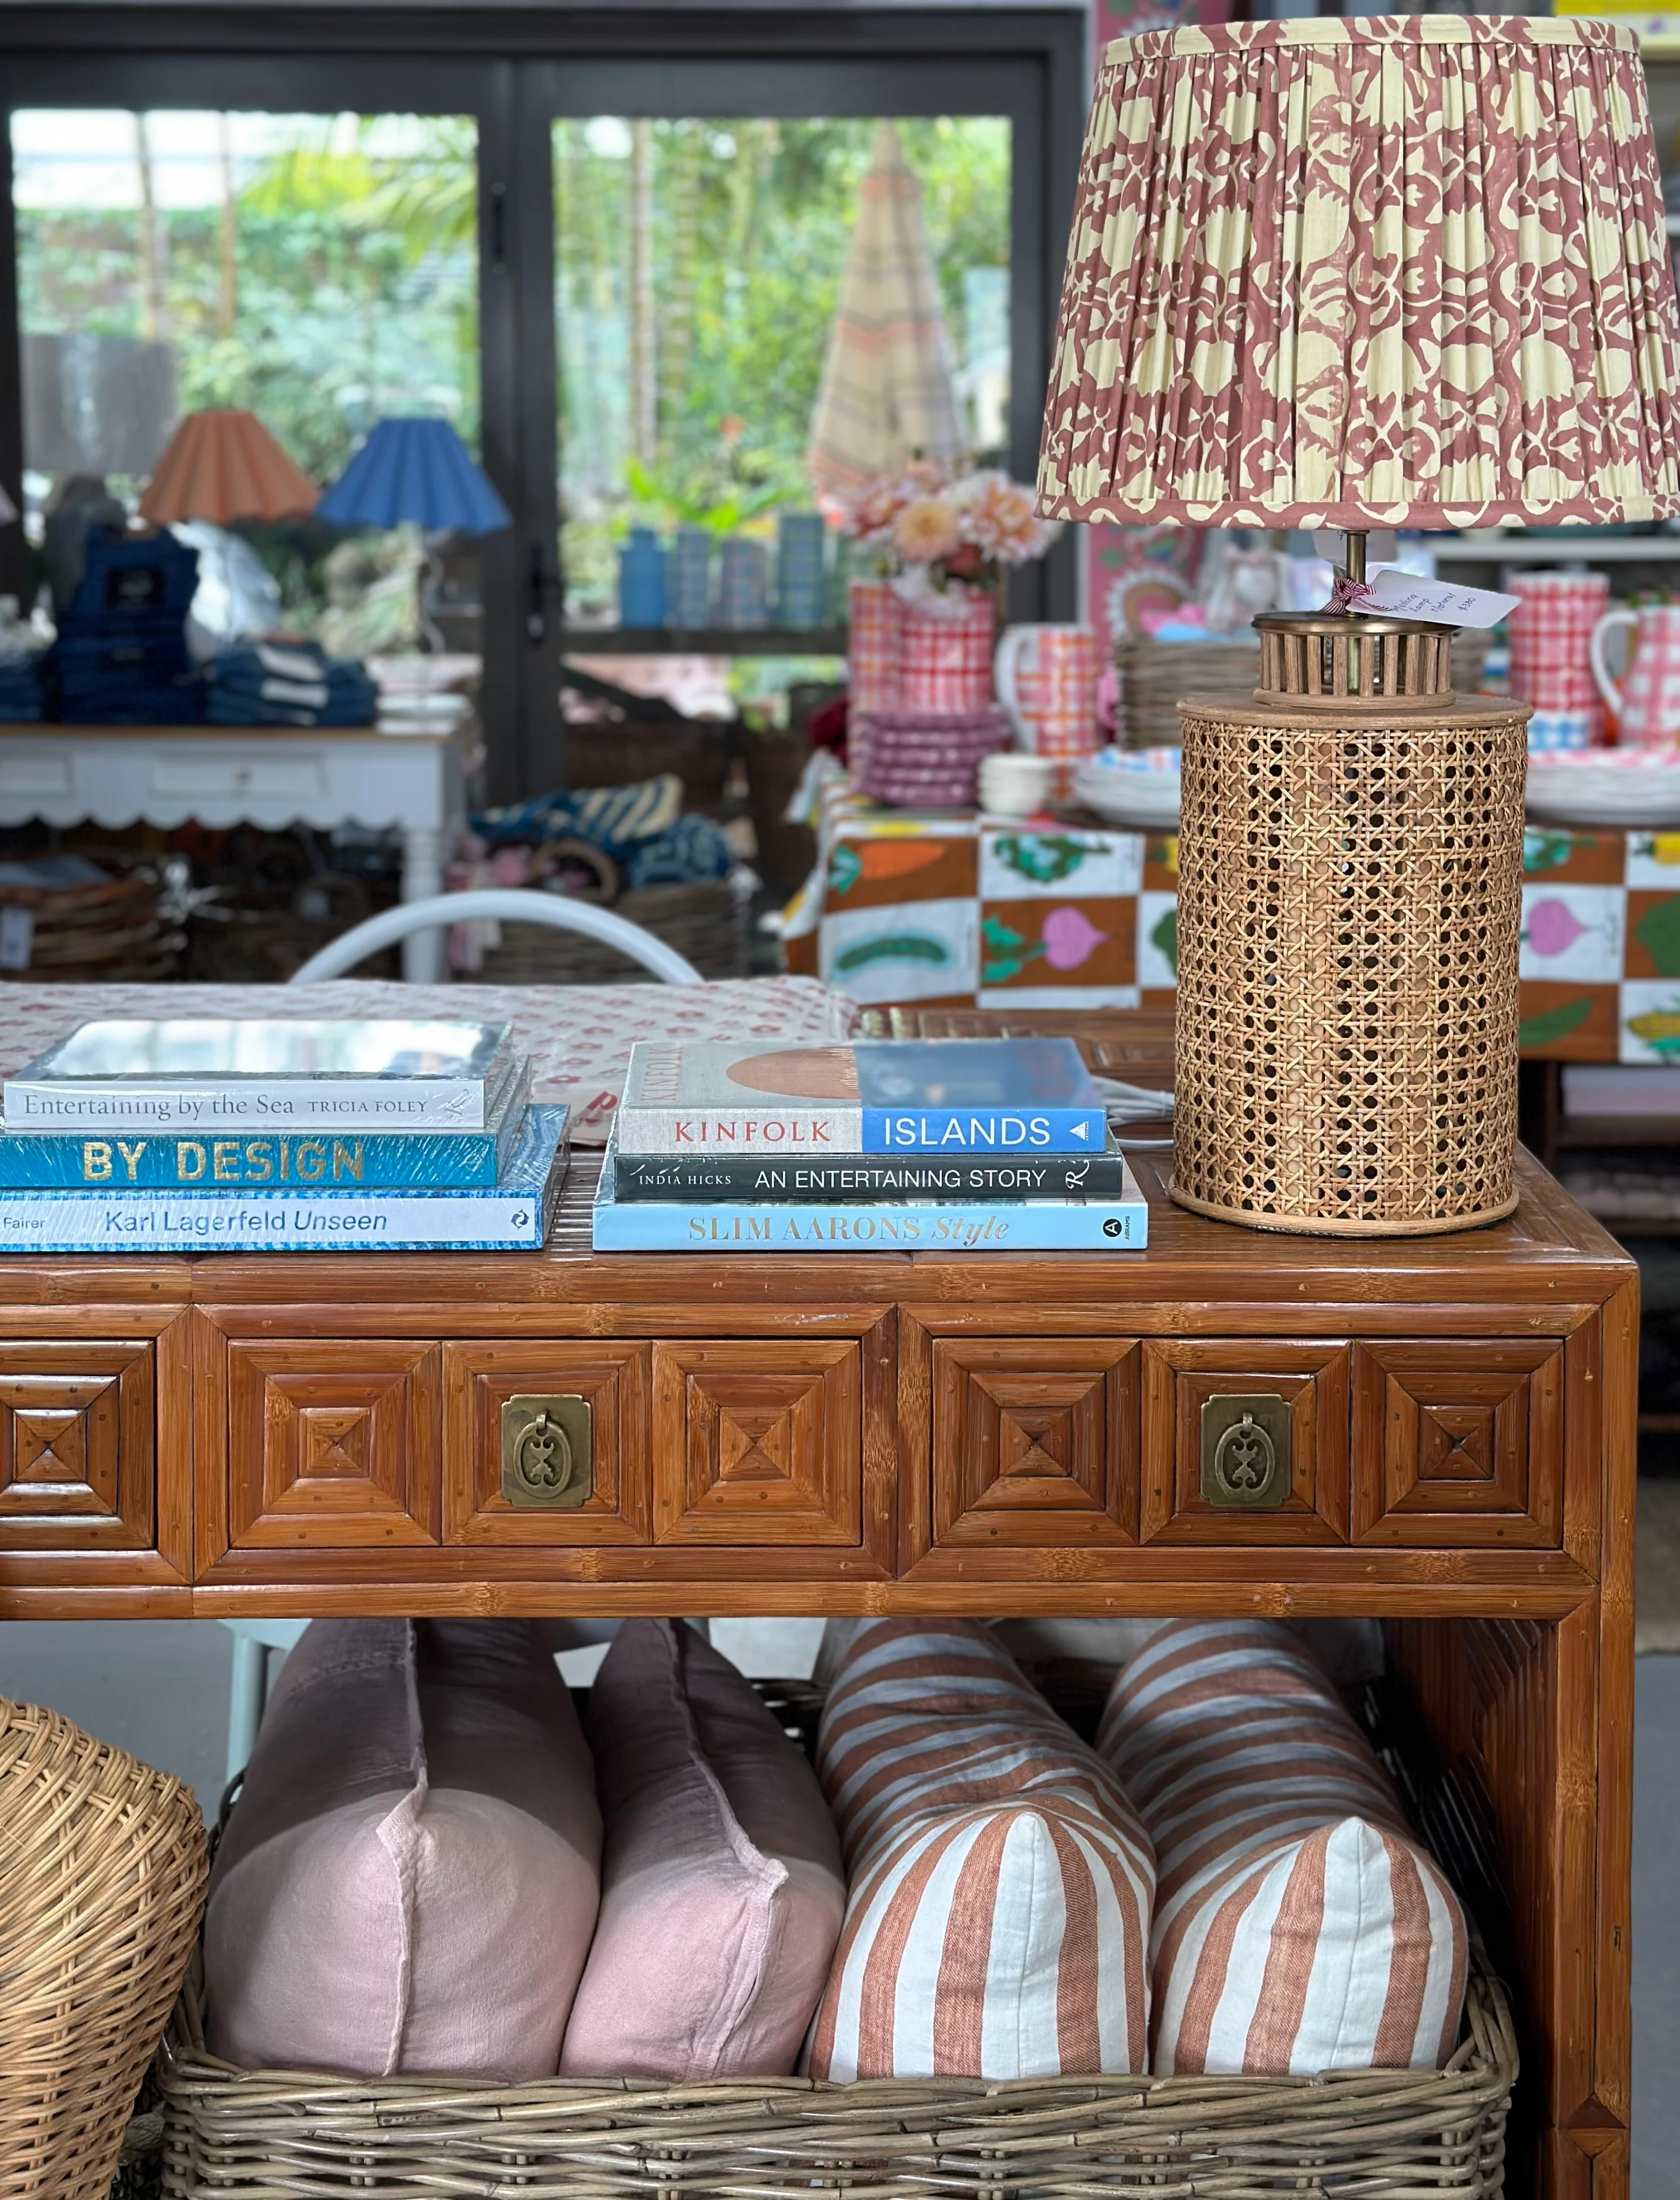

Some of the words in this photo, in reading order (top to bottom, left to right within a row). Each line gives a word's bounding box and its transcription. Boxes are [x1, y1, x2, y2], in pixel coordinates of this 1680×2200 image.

[641, 1047, 684, 1101] KINFOLK
[24, 1094, 171, 1121] Entertaining
[179, 1093, 204, 1121] by
[212, 1092, 247, 1114] the
[256, 1094, 294, 1114] Sea
[307, 1101, 369, 1113] TRICIA
[375, 1101, 429, 1113] FOLEY
[675, 1121, 831, 1142] KINFOLK
[885, 1118, 1050, 1145] ISLANDS
[83, 1142, 147, 1181] BY
[177, 1141, 364, 1181] DESIGN
[639, 1175, 681, 1185] INDIA
[688, 1175, 731, 1185] HICKS
[754, 1170, 786, 1188] AN
[795, 1170, 961, 1188] ENTERTAINING
[969, 1169, 1046, 1188] STORY
[4, 1217, 45, 1229] Fairer
[106, 1211, 155, 1232] Karl
[164, 1211, 286, 1236] Lagerfeld
[294, 1211, 387, 1231] Unseen
[689, 1217, 774, 1241] SLIM
[783, 1216, 921, 1241] AARONS
[931, 1215, 1010, 1247] Style
